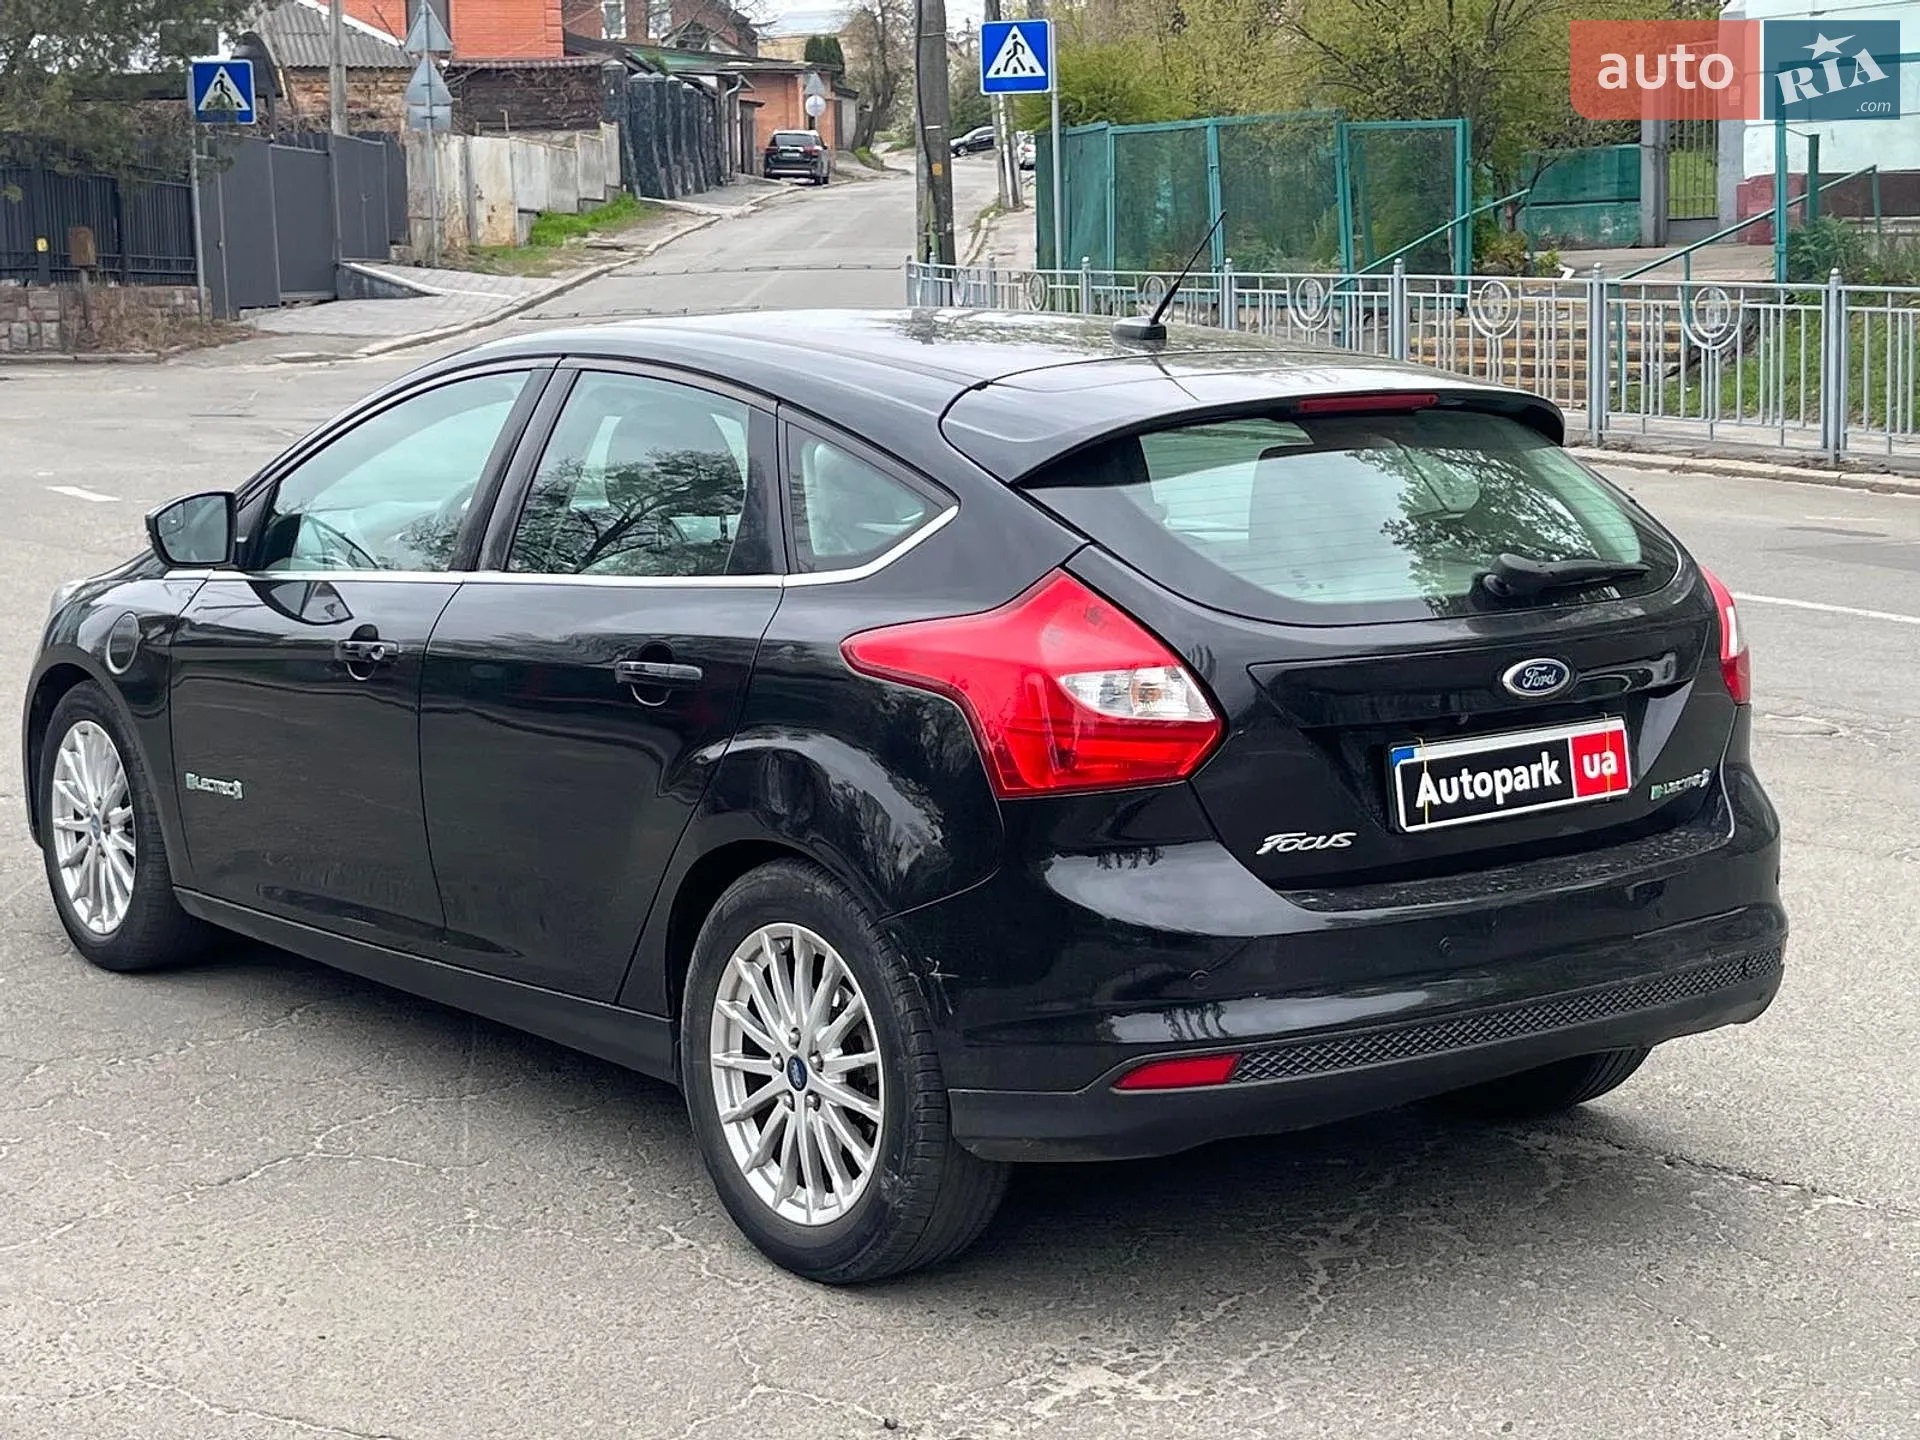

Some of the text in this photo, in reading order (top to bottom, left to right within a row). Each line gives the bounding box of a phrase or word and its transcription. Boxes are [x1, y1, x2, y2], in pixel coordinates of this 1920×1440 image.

[1522, 665, 1557, 688] Ford
[1416, 750, 1618, 808] Autopark ua
